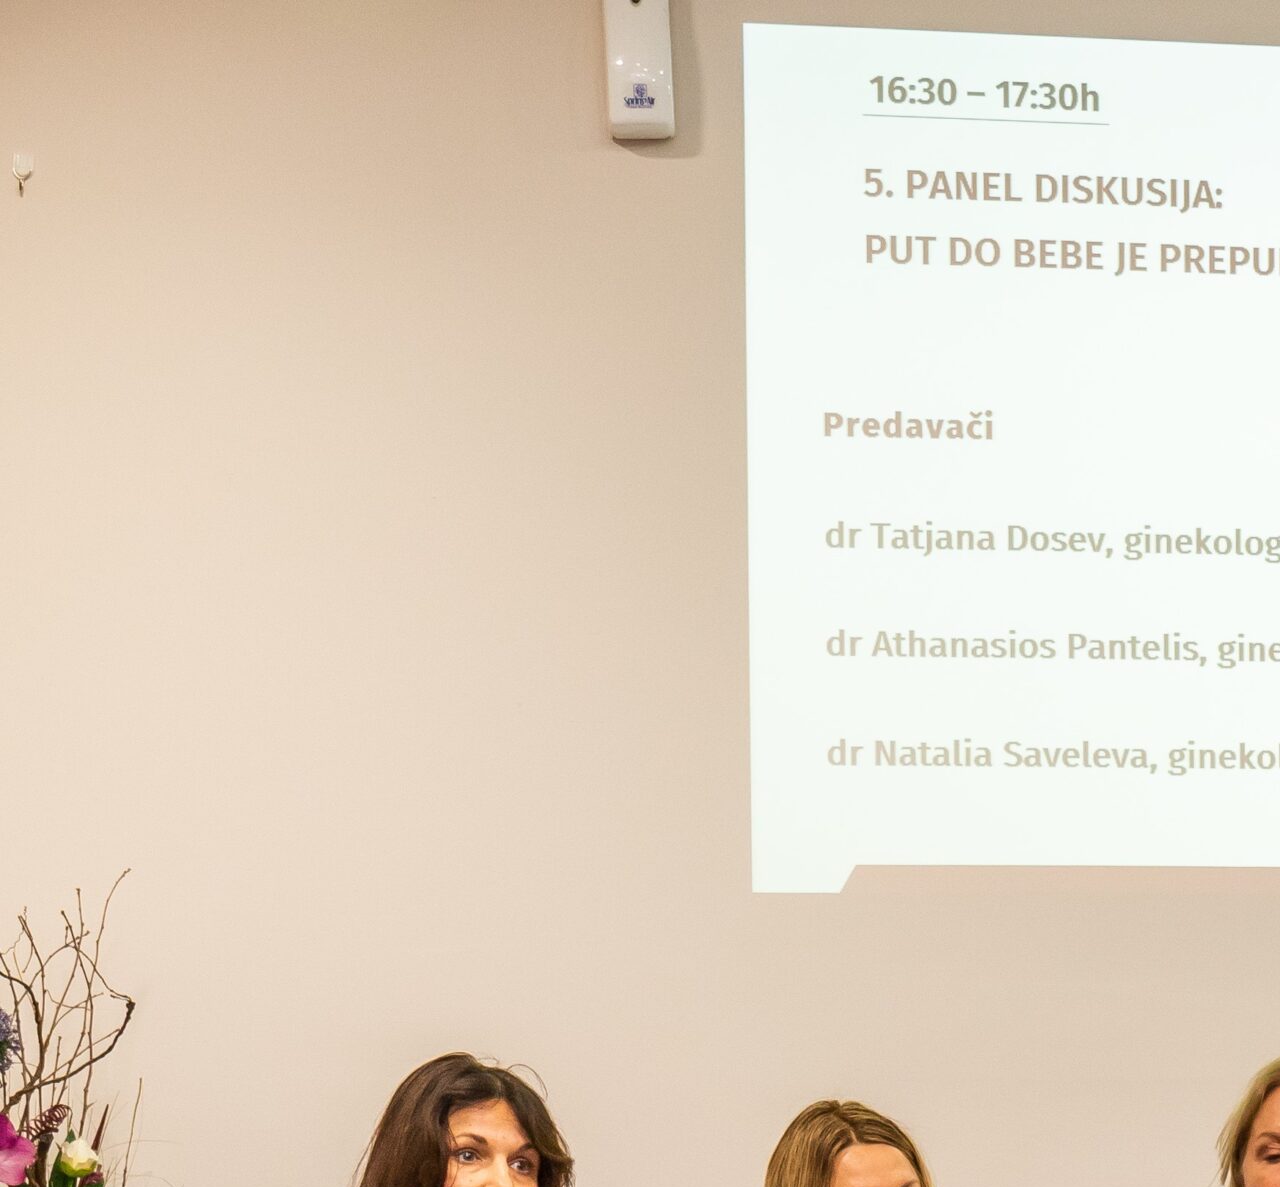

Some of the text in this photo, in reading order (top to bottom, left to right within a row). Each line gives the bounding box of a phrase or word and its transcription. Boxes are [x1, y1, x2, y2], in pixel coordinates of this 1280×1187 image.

[868, 75, 958, 106] 16:30
[995, 79, 1101, 112] 17:30h
[864, 168, 1223, 214] 5. PANEL DISKUSIJA:
[866, 234, 937, 265] PUT
[949, 237, 1001, 267] DO
[1014, 239, 1104, 270] BEBE
[1114, 242, 1147, 276] JE
[823, 410, 994, 440] Predavači
[825, 521, 862, 548] dr
[870, 521, 996, 557] Tatjana
[1008, 525, 1113, 559] Dosev,
[826, 629, 863, 656] dr
[872, 630, 1056, 659] Athanasios
[1068, 632, 1207, 667] Pantelis,
[827, 738, 864, 766] dr
[875, 738, 992, 767] Natalia
[1004, 741, 1157, 774] Saveleva,
